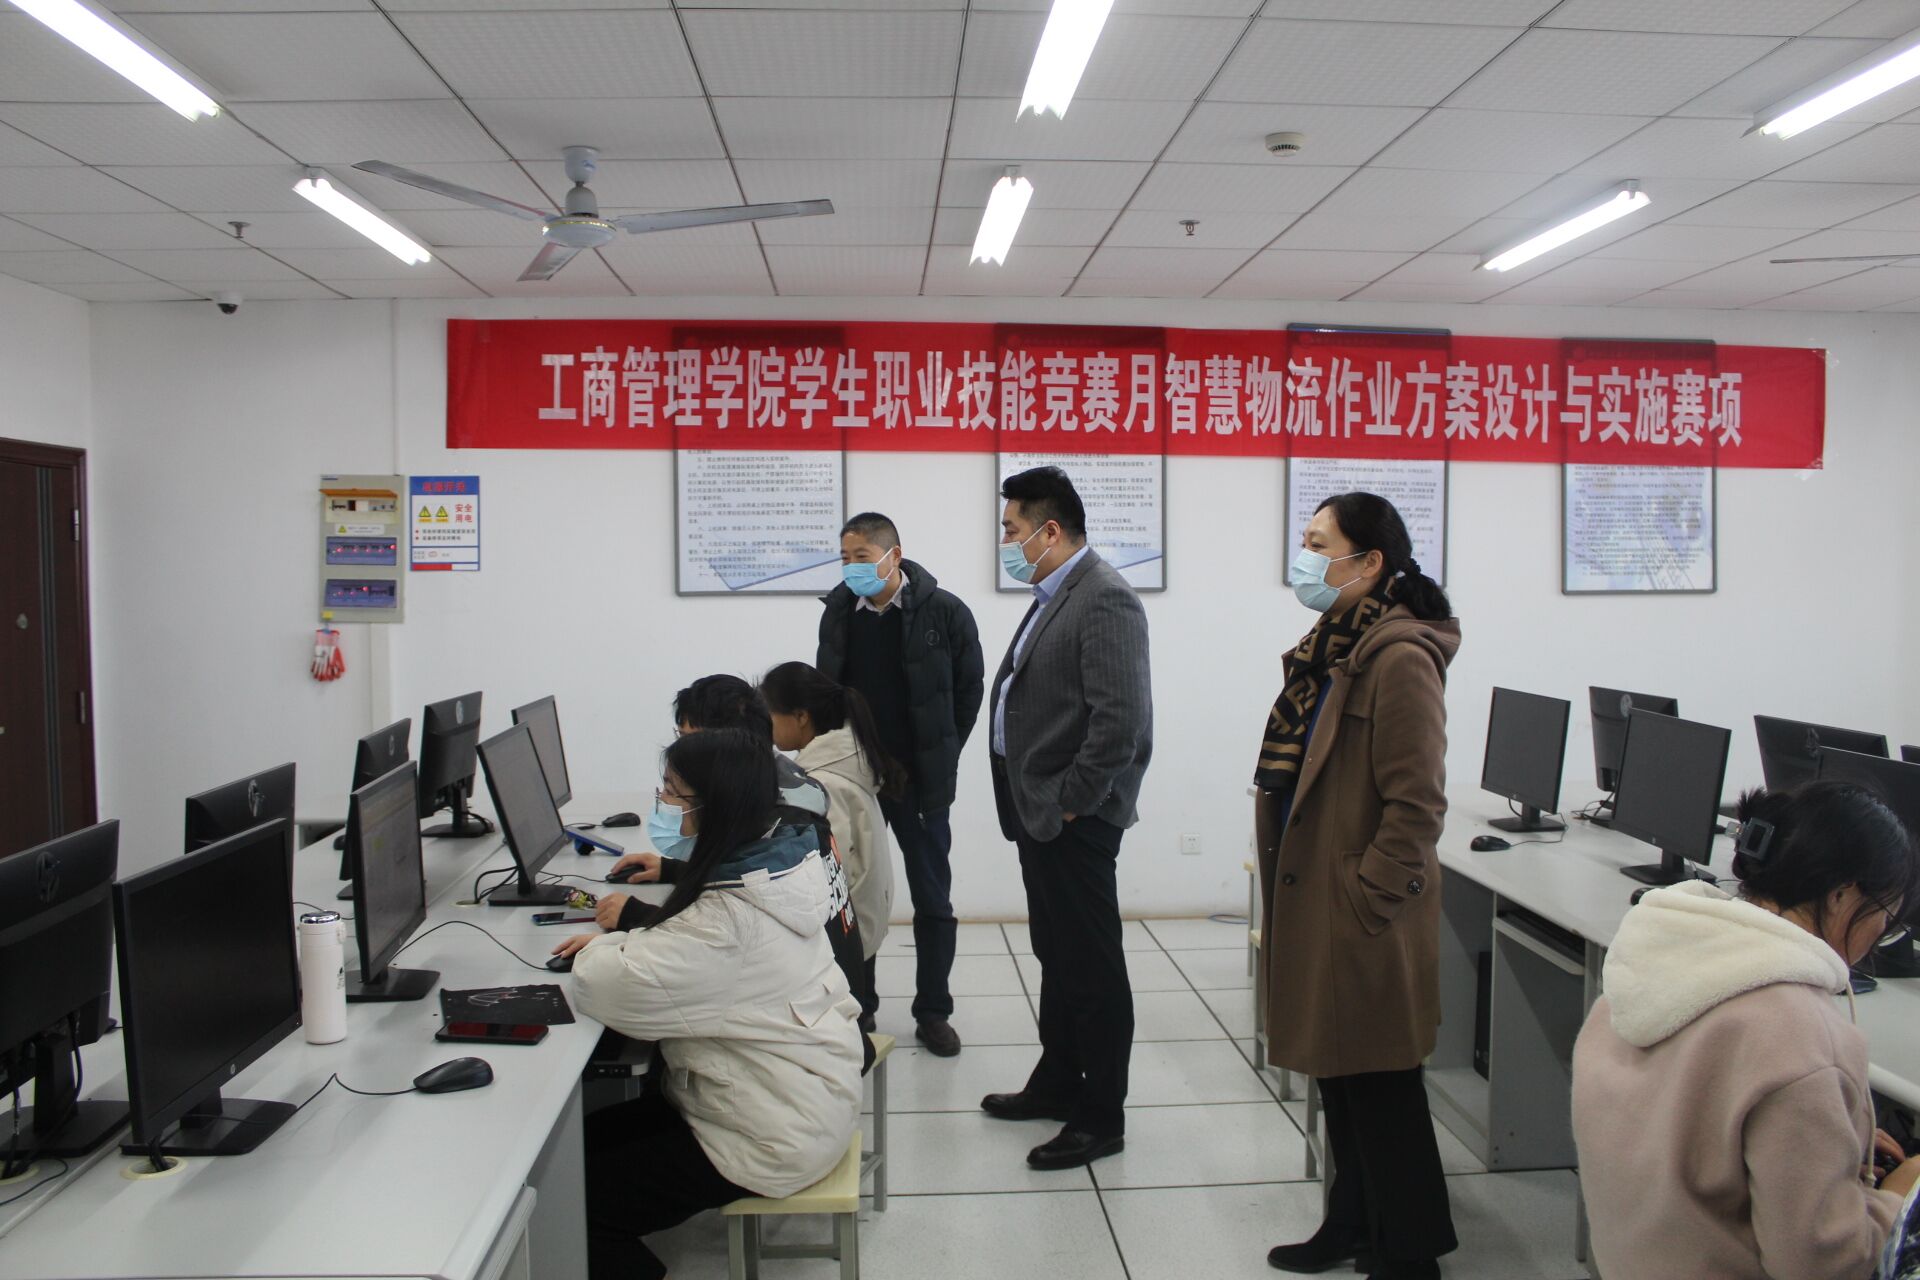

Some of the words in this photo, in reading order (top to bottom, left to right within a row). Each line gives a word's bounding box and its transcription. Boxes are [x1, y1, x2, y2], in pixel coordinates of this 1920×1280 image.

[538, 344, 1743, 448] 工商管理学院学生职业技能竞赛月智慧物流作业方案设计与实施赛项
